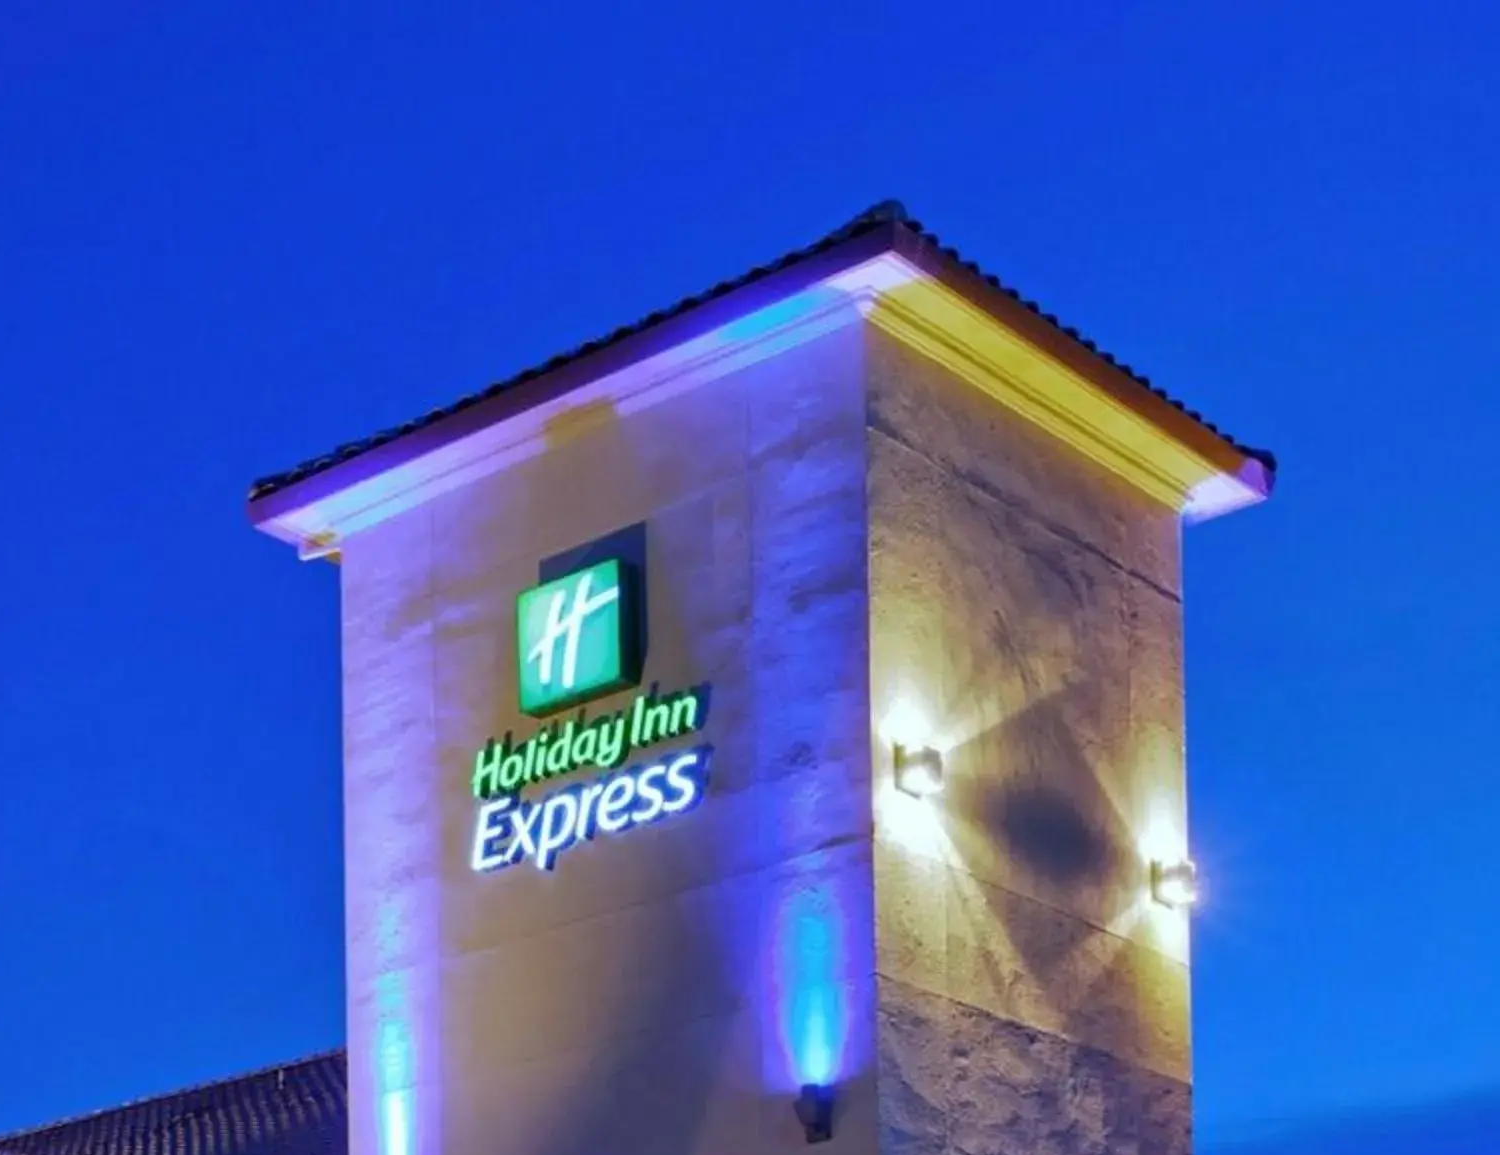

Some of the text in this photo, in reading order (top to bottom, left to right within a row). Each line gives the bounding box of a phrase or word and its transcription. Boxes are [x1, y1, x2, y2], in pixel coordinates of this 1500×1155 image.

[527, 572, 619, 688] H
[473, 695, 697, 797] Holiday Inn
[471, 754, 698, 871] Express
